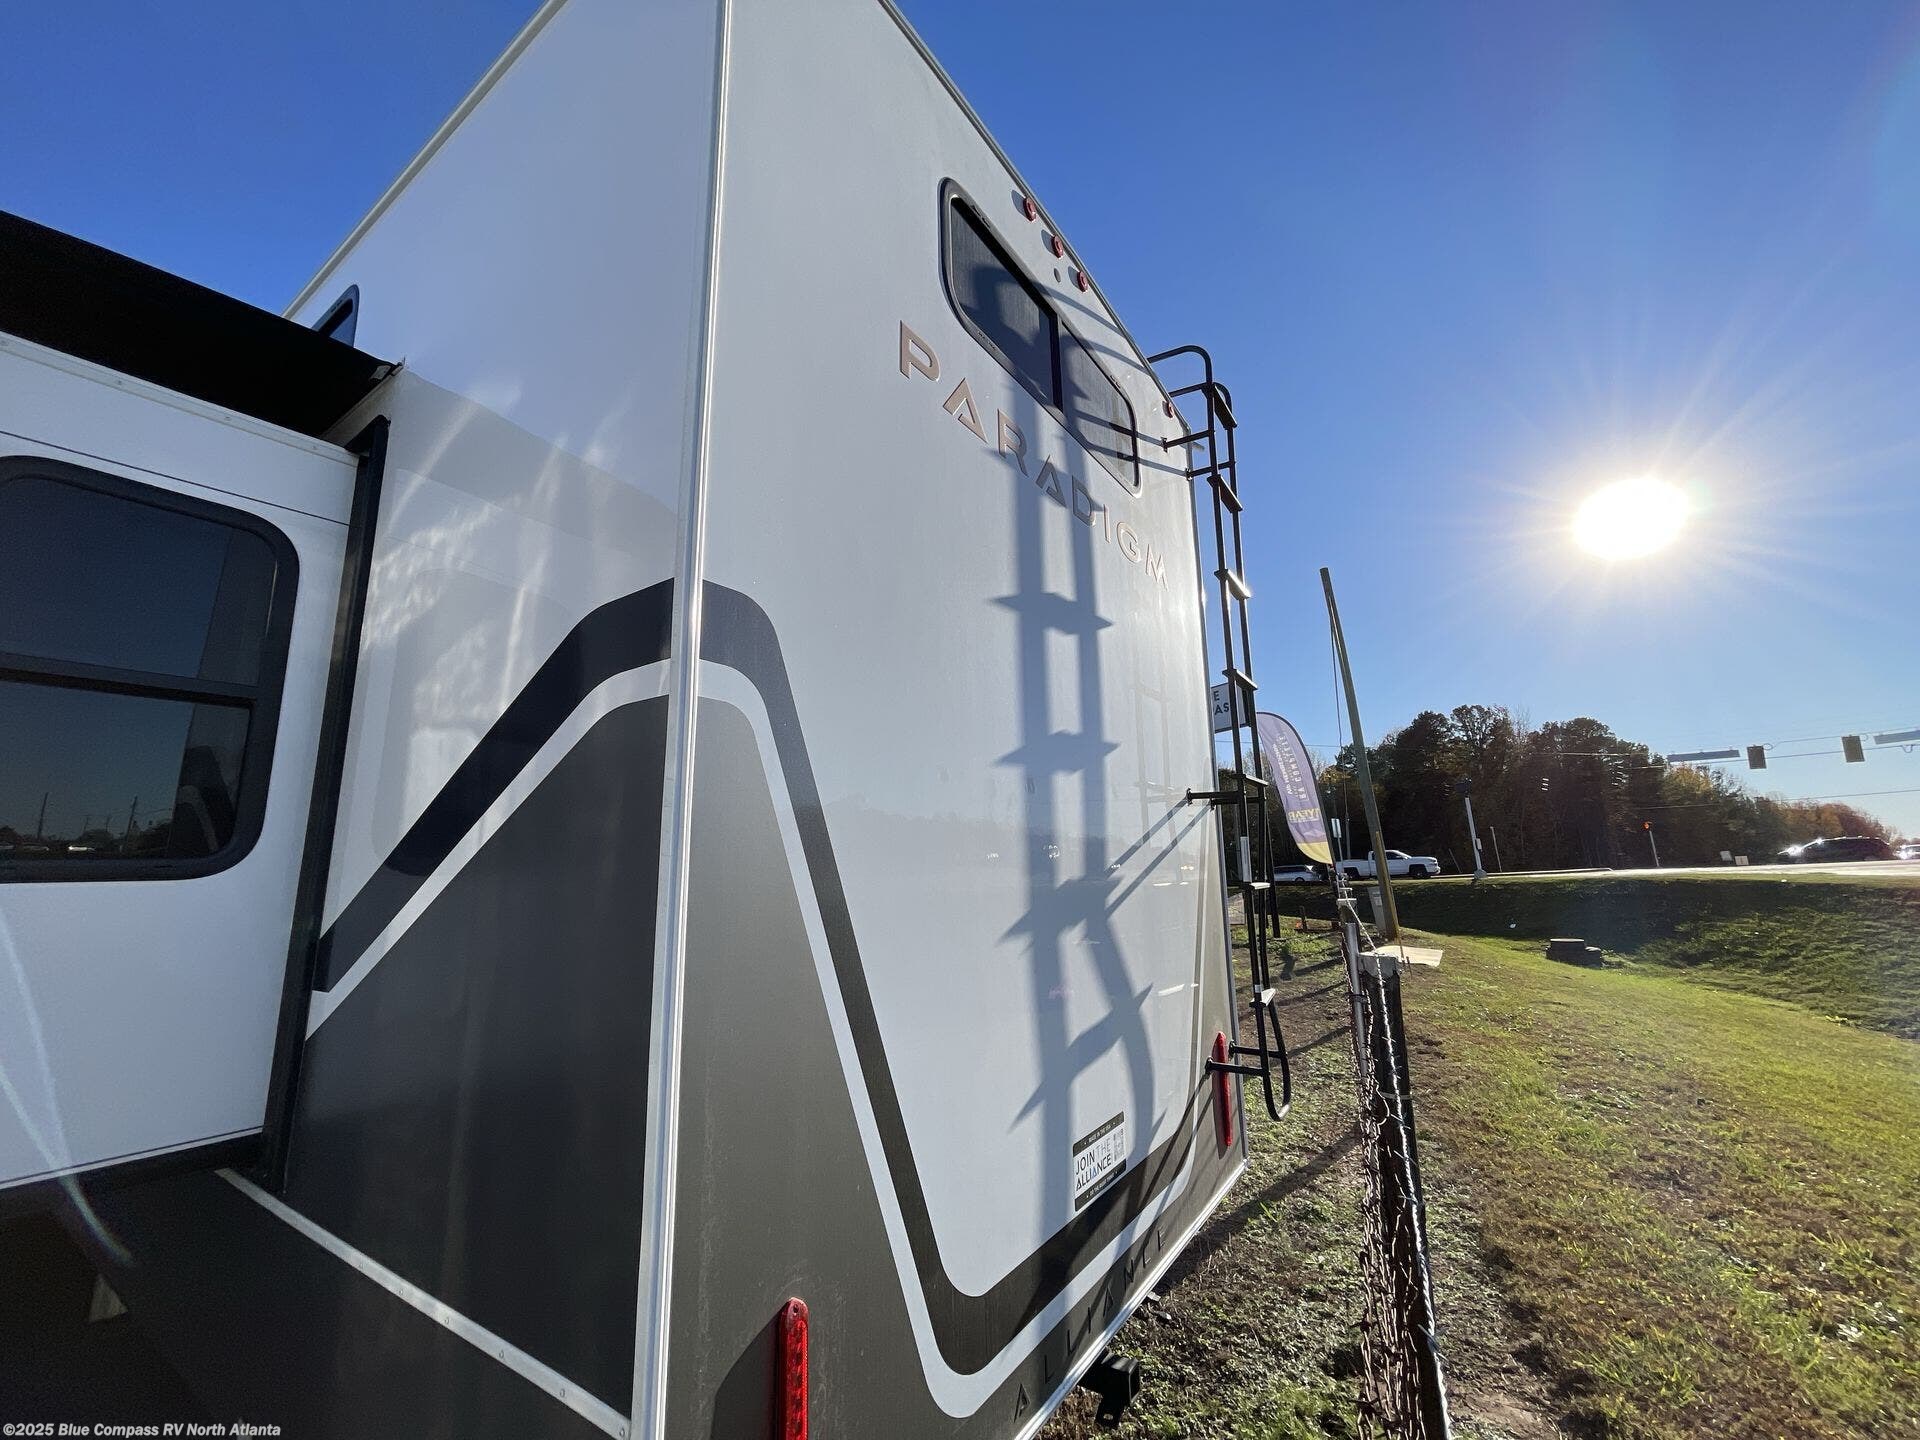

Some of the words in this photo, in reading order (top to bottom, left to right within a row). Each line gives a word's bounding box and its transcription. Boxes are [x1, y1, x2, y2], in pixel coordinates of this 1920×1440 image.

[900, 320, 1168, 591] PARADIGM
[1076, 1149, 1095, 1175] JOIN
[1096, 1137, 1111, 1158] THE
[1076, 1153, 1111, 1192] ALLIANCE
[1014, 1226, 1167, 1423] ALLIANCE
